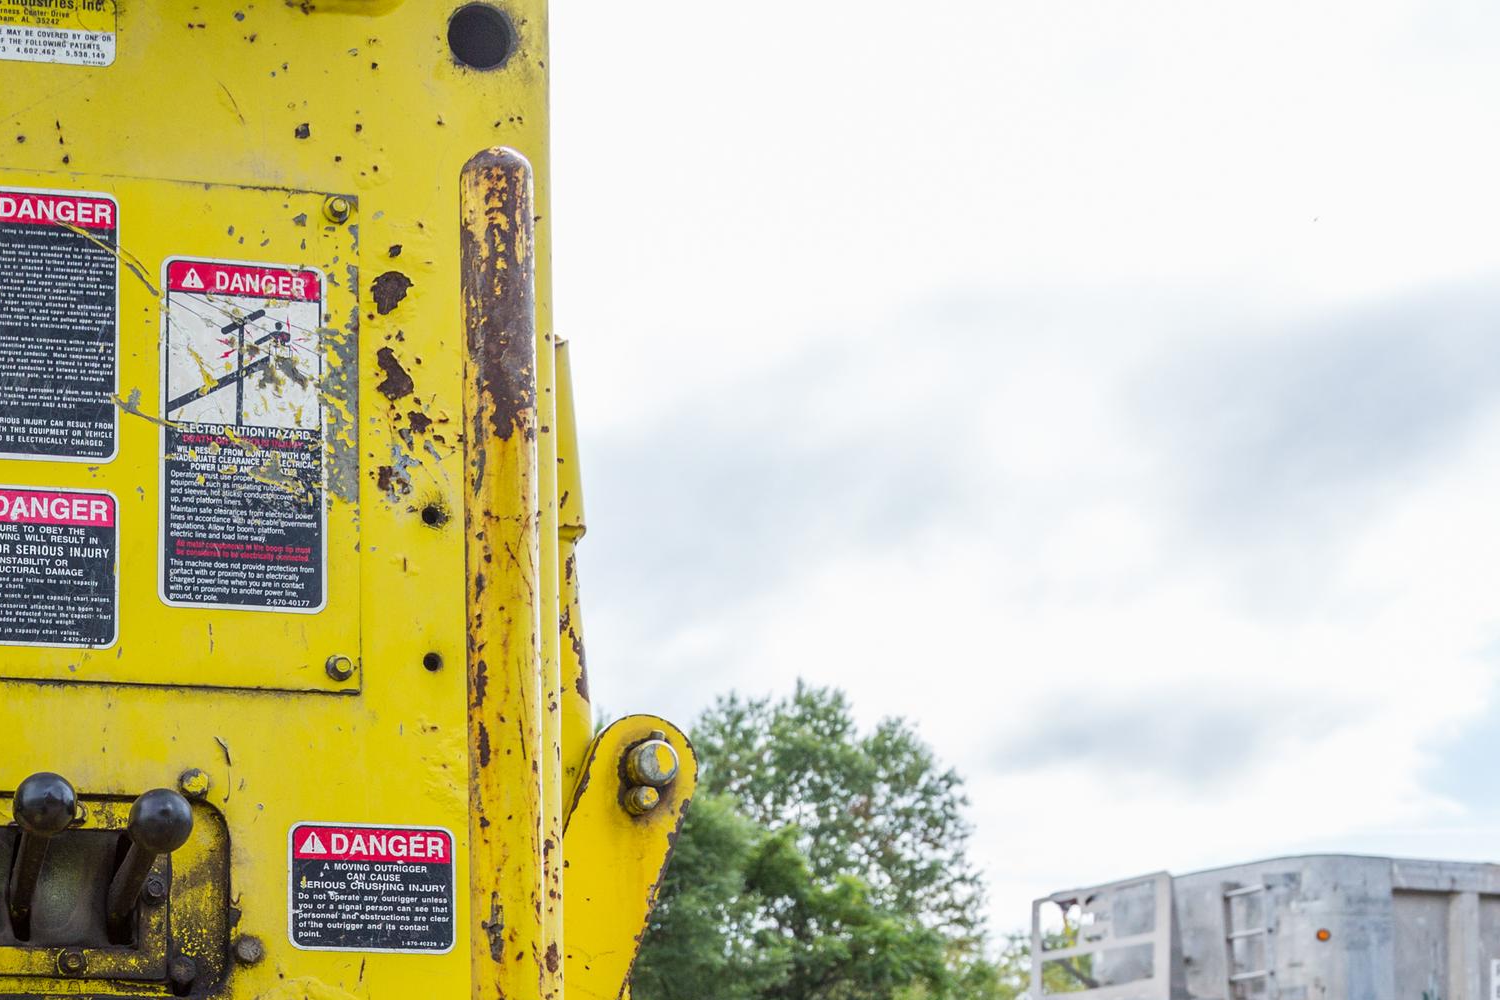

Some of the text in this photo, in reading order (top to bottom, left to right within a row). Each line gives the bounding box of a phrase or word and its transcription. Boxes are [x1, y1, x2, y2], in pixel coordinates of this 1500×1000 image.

[26, 39, 66, 48] FOLLOWING
[70, 42, 100, 50] PATENTS
[0, 198, 111, 224] DANGER
[215, 272, 305, 297] DANGER
[24, 418, 46, 426] INJURY
[29, 428, 68, 436] EQUIPMENT
[18, 436, 67, 445] ELECTRICALLY
[71, 438, 105, 447] CHARGED.
[224, 447, 310, 461] FROM WITH OR
[218, 456, 260, 465] CLEARANCE
[39, 526, 63, 534] OBEY
[68, 527, 85, 535] THE
[25, 534, 46, 542] WILL
[51, 535, 84, 544] RESULT
[16, 545, 63, 556] SERIOUS
[70, 547, 109, 558] INJURY
[46, 568, 83, 576] DAMAGE
[332, 834, 444, 858] DANGER
[334, 863, 370, 871] MOVING
[375, 865, 427, 873] OUTRIGGER
[350, 883, 404, 891] CRUSHING
[409, 884, 446, 892] INJURY
[330, 893, 360, 902] operate
[364, 895, 378, 903] any
[382, 895, 418, 904] outrigger
[338, 903, 362, 911] signal
[366, 905, 393, 913] person
[433, 905, 448, 913] that
[361, 913, 410, 921] obstructions
[327, 922, 364, 930] outrigger
